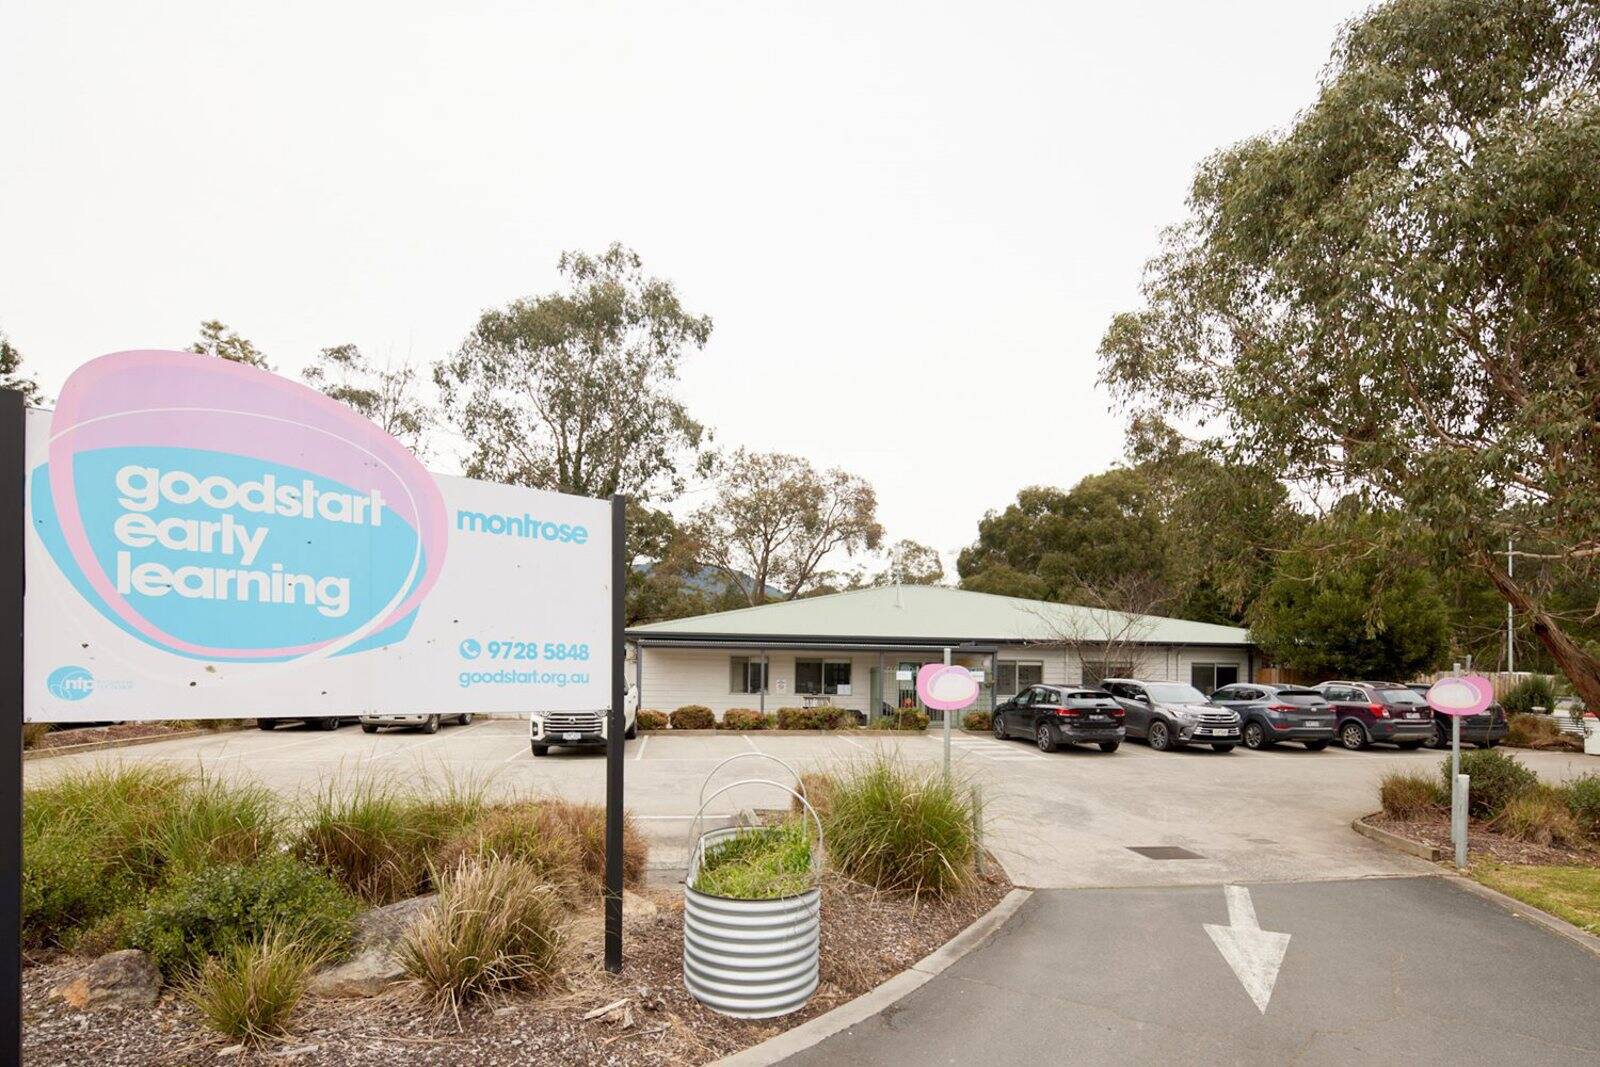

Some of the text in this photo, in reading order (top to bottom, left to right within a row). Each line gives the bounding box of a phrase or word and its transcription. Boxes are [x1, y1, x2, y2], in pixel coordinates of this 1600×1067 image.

[117, 466, 386, 526] goodstart
[115, 514, 269, 566] early
[457, 511, 588, 545] montrose
[117, 551, 350, 616] learning
[487, 640, 590, 661] 9728 5848
[460, 671, 589, 688] goodstart.org.au
